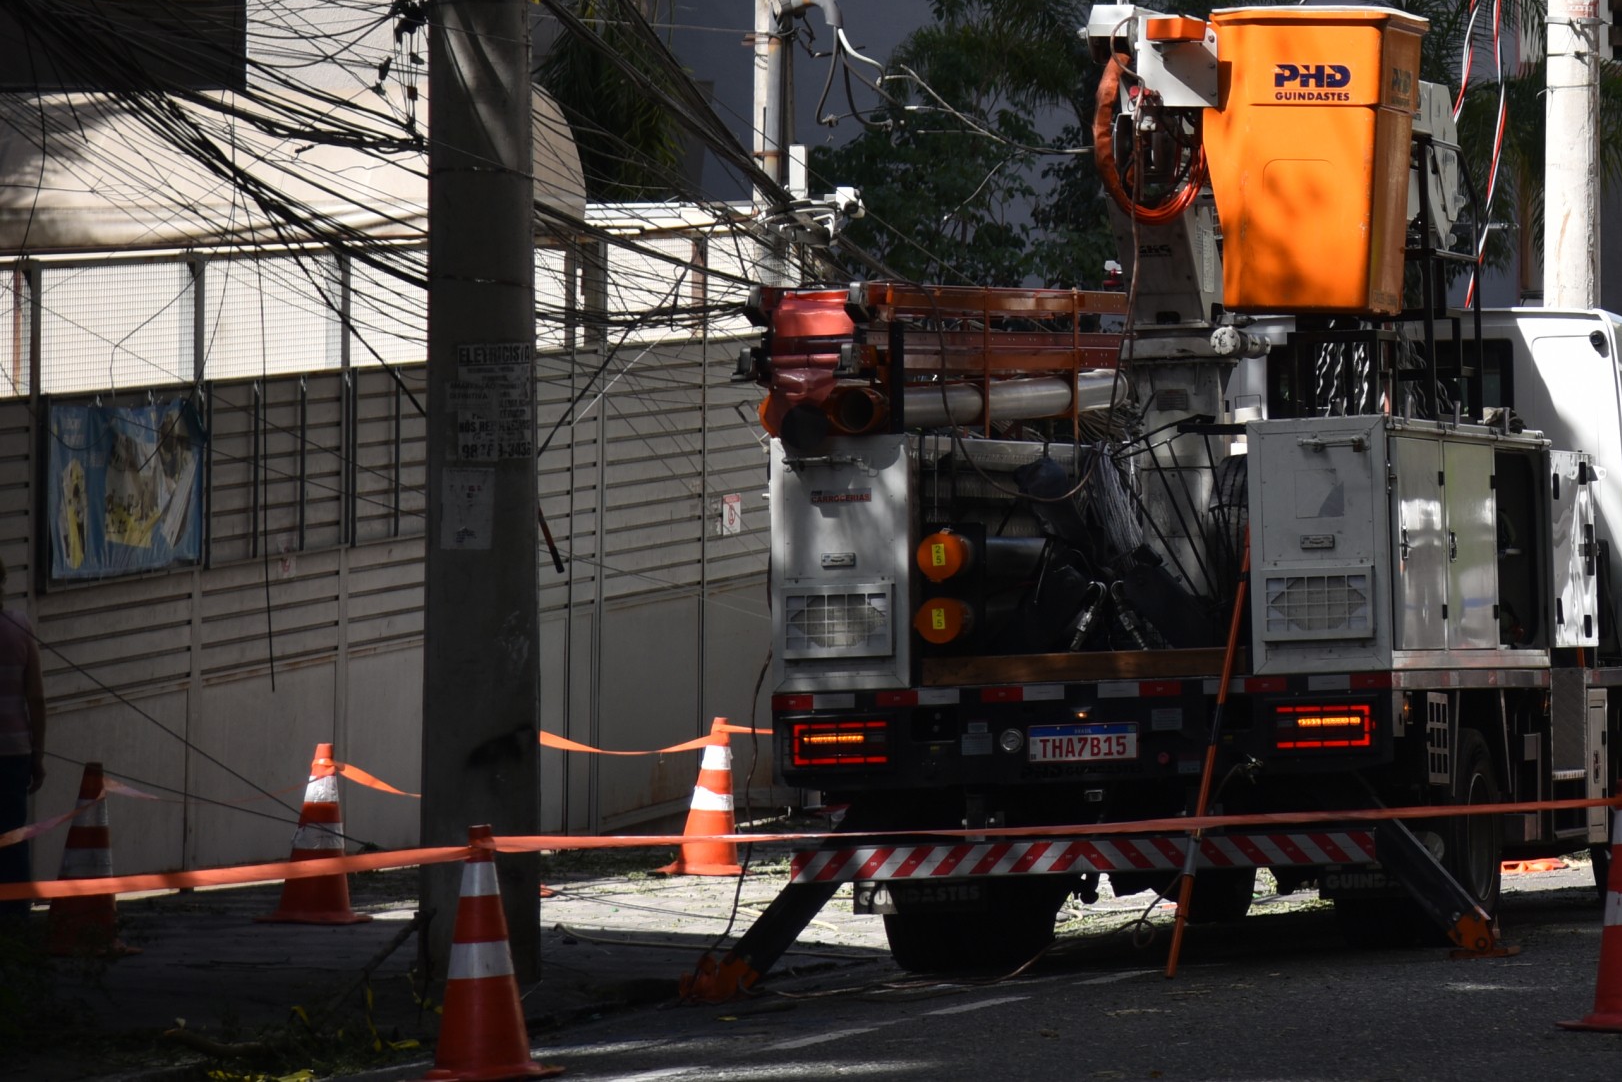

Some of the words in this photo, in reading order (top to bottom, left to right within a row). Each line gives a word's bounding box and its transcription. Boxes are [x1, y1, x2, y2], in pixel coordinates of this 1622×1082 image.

[1274, 64, 1351, 88] PHD
[1274, 91, 1350, 102] GUINDASTES
[458, 345, 530, 366] ELETRICISTA
[811, 494, 870, 503] CARROCERIAS
[1039, 735, 1127, 759] THA7B15
[859, 885, 980, 907] GUINDASTES
